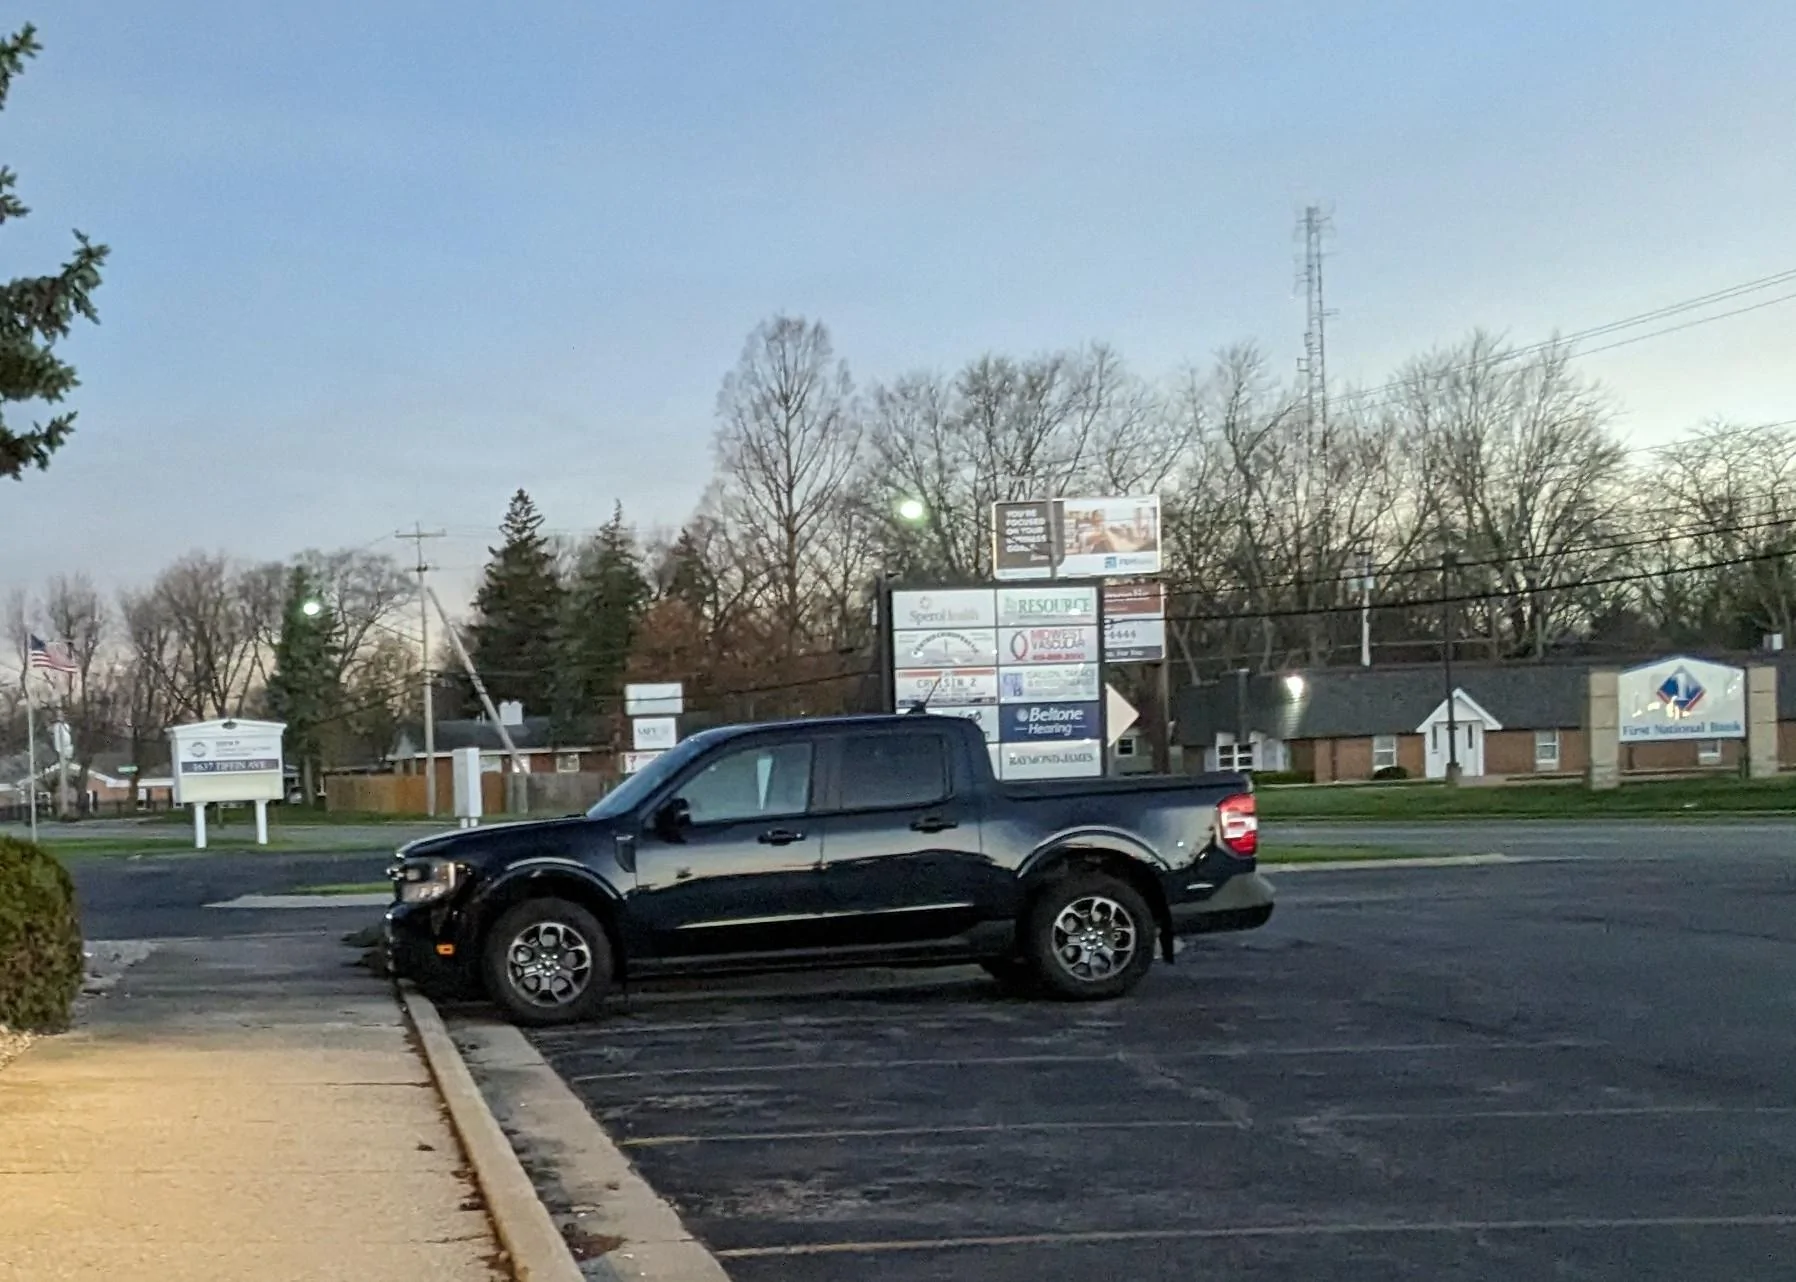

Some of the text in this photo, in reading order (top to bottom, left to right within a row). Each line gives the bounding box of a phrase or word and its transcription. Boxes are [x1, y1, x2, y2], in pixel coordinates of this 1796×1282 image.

[1018, 598, 1091, 613] RESOURCE
[1028, 707, 1084, 721] Beltone
[1028, 723, 1072, 736] Hearing
[1623, 720, 1741, 736] First National Bank
